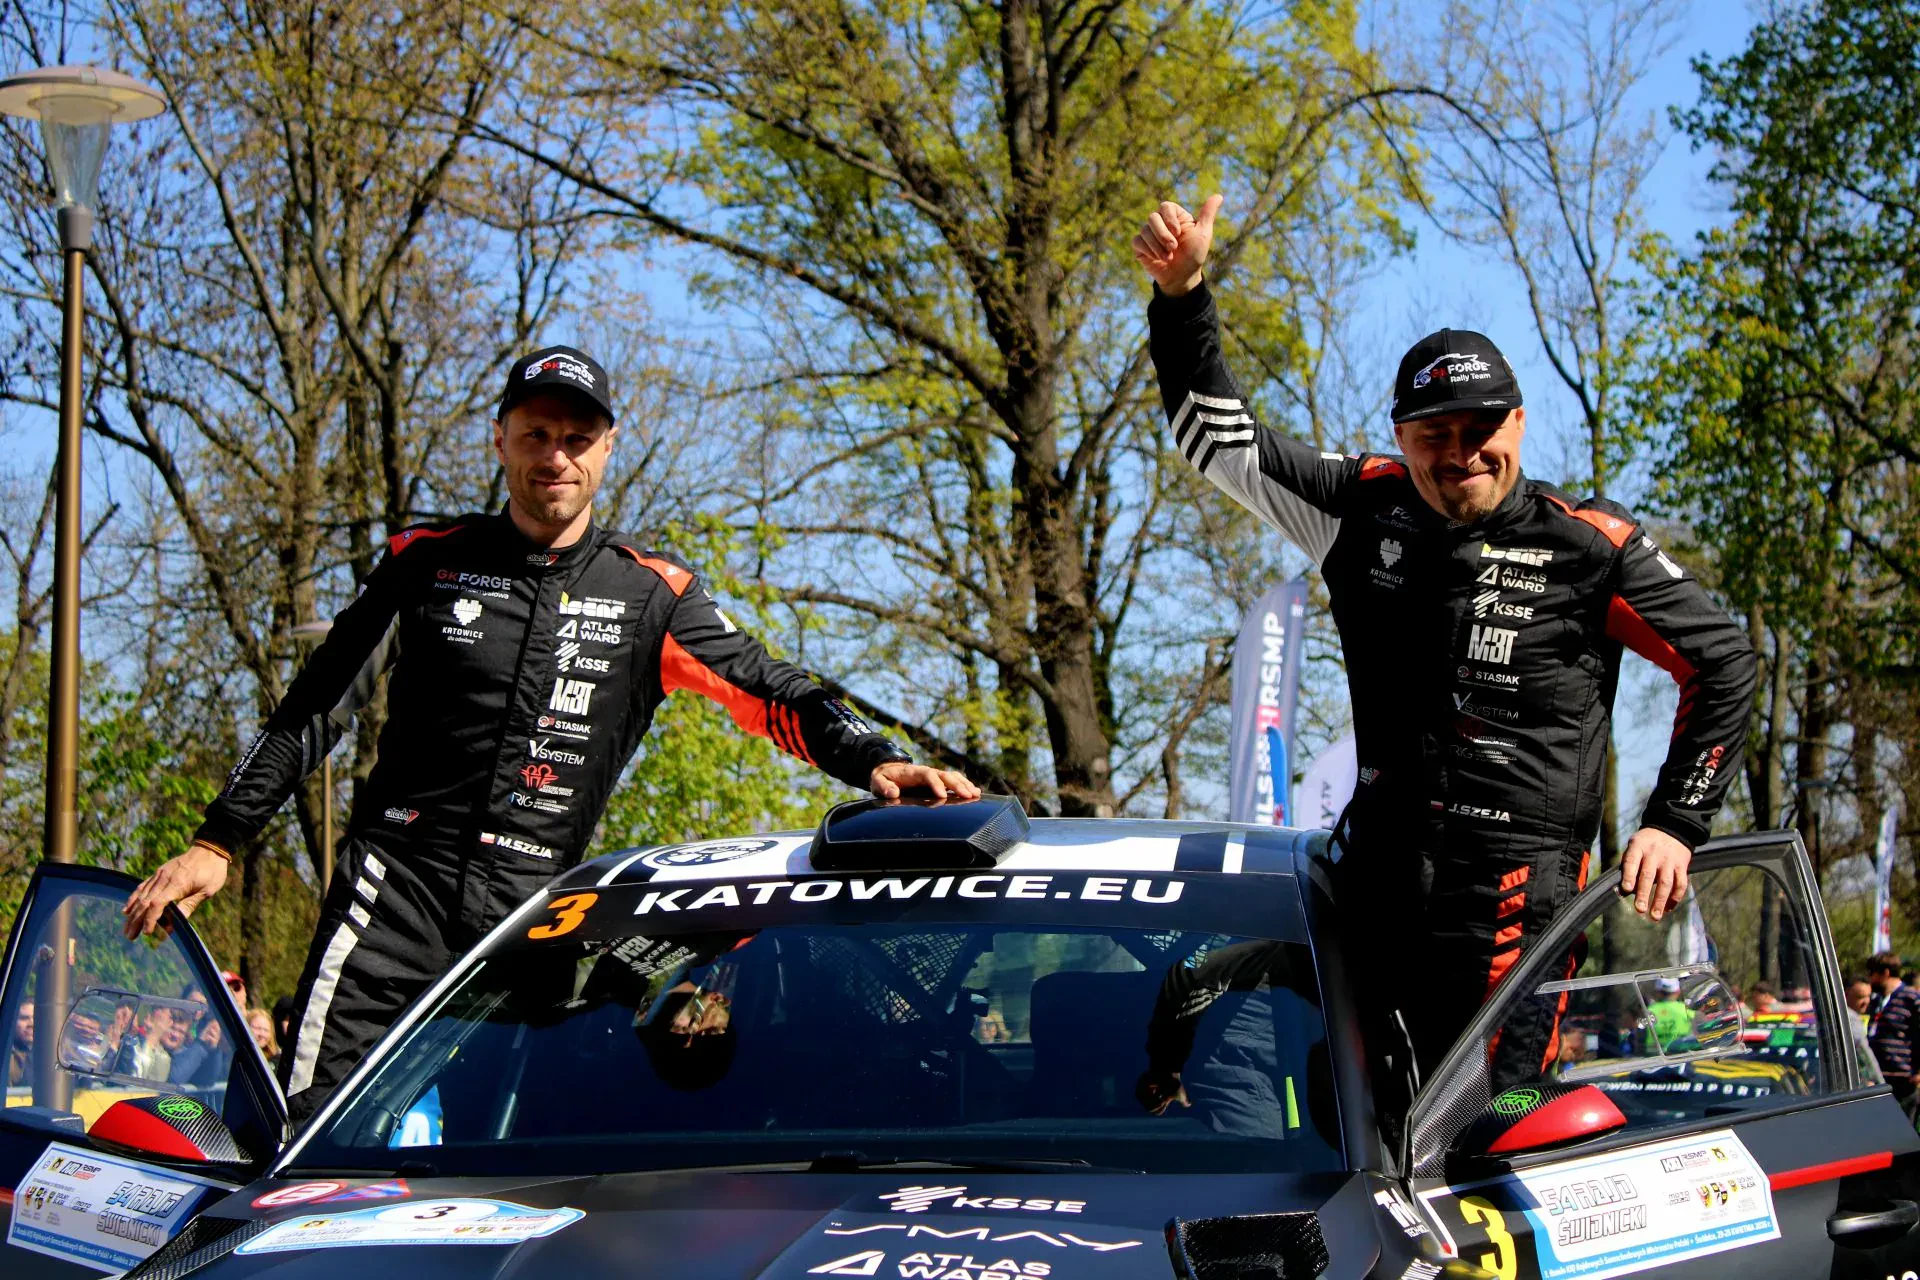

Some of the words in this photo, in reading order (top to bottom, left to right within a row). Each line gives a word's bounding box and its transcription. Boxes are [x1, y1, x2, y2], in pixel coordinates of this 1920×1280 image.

[1450, 374, 1470, 383] Rally
[1471, 372, 1490, 380] Team
[436, 570, 511, 590] GKFORGE
[1370, 568, 1404, 584] KATOWICE
[1502, 566, 1547, 583] ATLAS
[1501, 577, 1546, 593] WARD
[1493, 602, 1534, 620] KSSE
[442, 627, 484, 639] KATOWICE
[580, 620, 622, 634] ATLAS
[580, 630, 621, 645] WARD
[574, 656, 610, 673] KSSE
[1259, 611, 1285, 707] RSMP
[1475, 671, 1519, 685] STASIAK
[555, 720, 591, 733] STASIAK
[1449, 803, 1510, 822] J.SZEJA
[497, 836, 552, 859] M.SZEJA
[634, 876, 1187, 914] KATOWICE.EU
[527, 893, 599, 939] 3
[414, 1206, 458, 1220] 3
[952, 1196, 1087, 1213] KSSE
[1460, 1196, 1517, 1280] 3
[899, 1252, 1051, 1276] ATLAS
